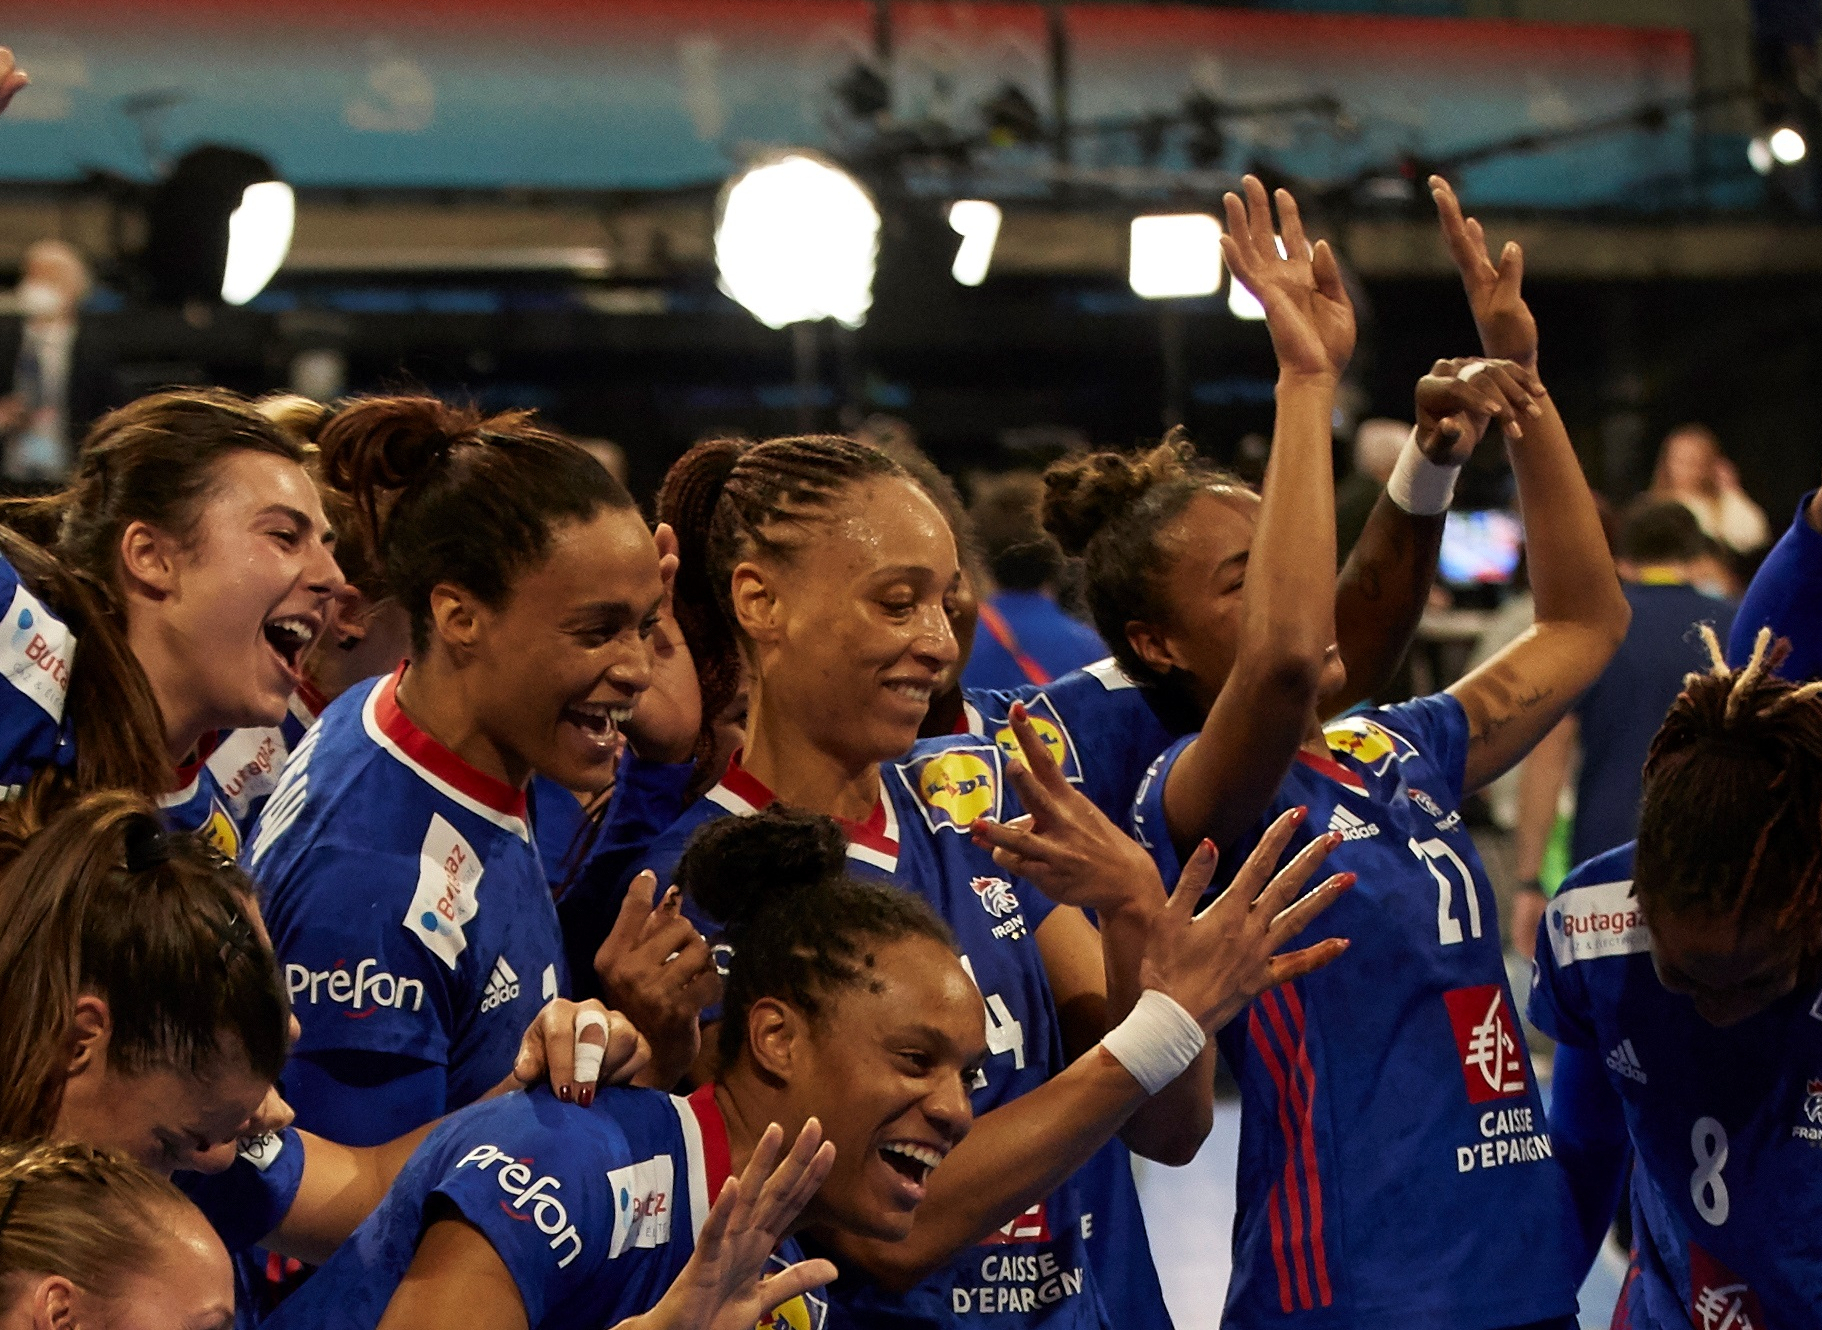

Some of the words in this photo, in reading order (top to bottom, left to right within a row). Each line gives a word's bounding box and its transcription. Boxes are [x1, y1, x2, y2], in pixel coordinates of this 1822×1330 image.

[1479, 1107, 1534, 1138] CAISSE
[1690, 1116, 1729, 1226] 8
[981, 1252, 1060, 1283] CAISSE
